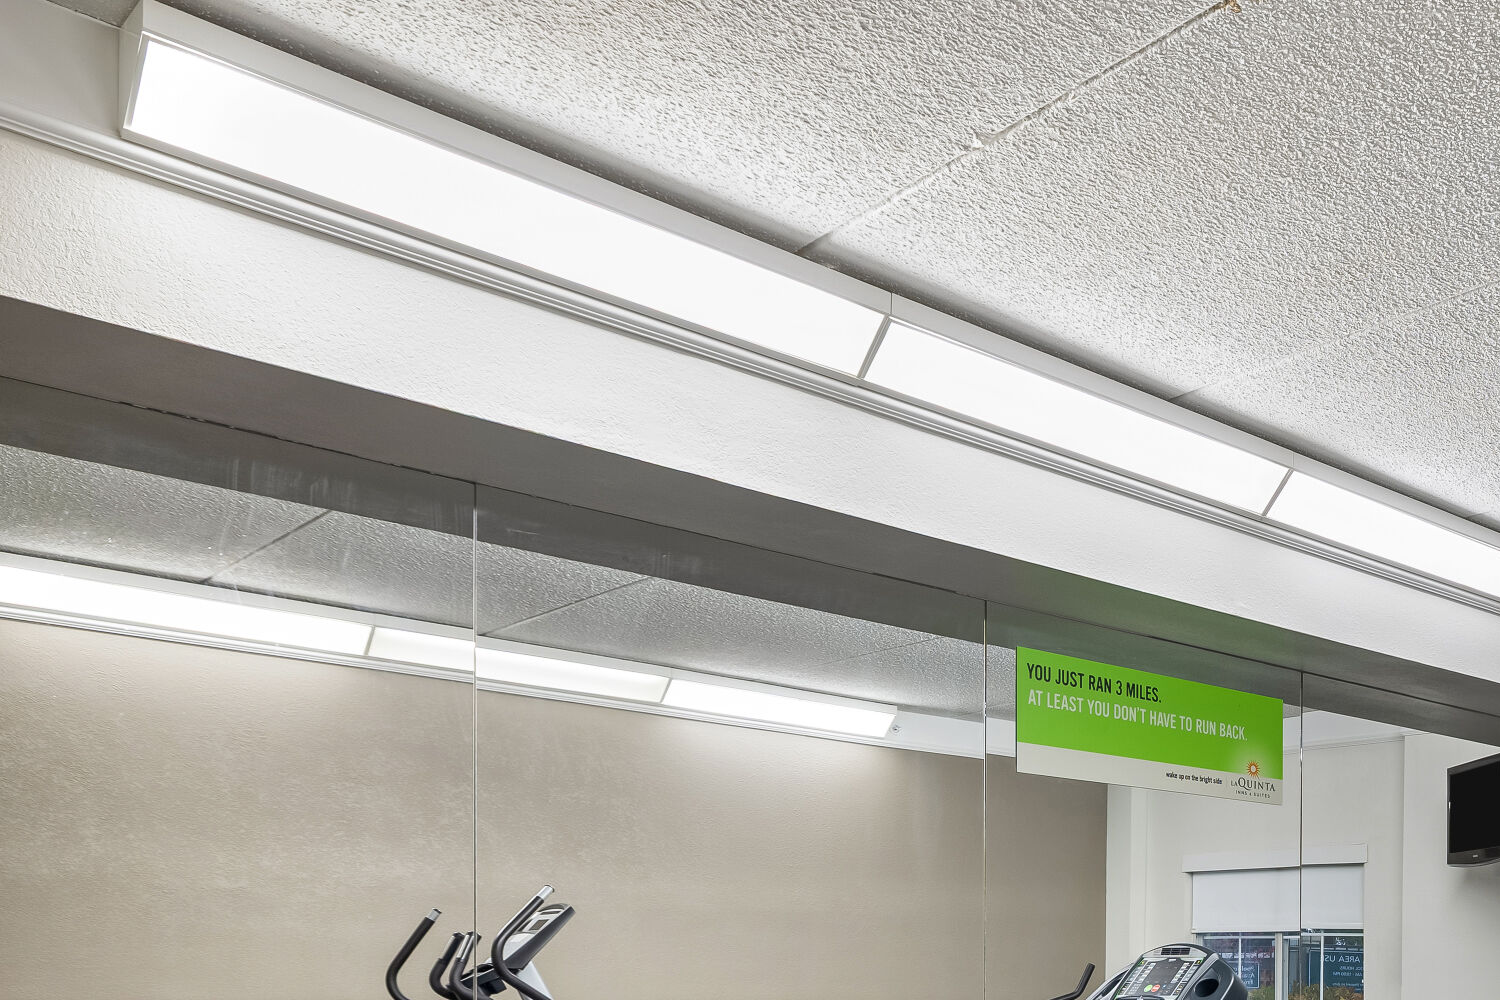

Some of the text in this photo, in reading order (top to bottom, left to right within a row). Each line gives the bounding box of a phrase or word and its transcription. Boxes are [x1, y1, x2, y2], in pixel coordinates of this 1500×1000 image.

[1026, 662, 1162, 703] YOU JUST RAN 3 MILES.
[1027, 688, 1248, 741] AT LEAST YOU DON'T HAVE TO RUN BACK.
[1165, 771, 1178, 779] wake
[1178, 774, 1184, 782] up
[1199, 775, 1213, 785] bright
[1213, 776, 1223, 785] side
